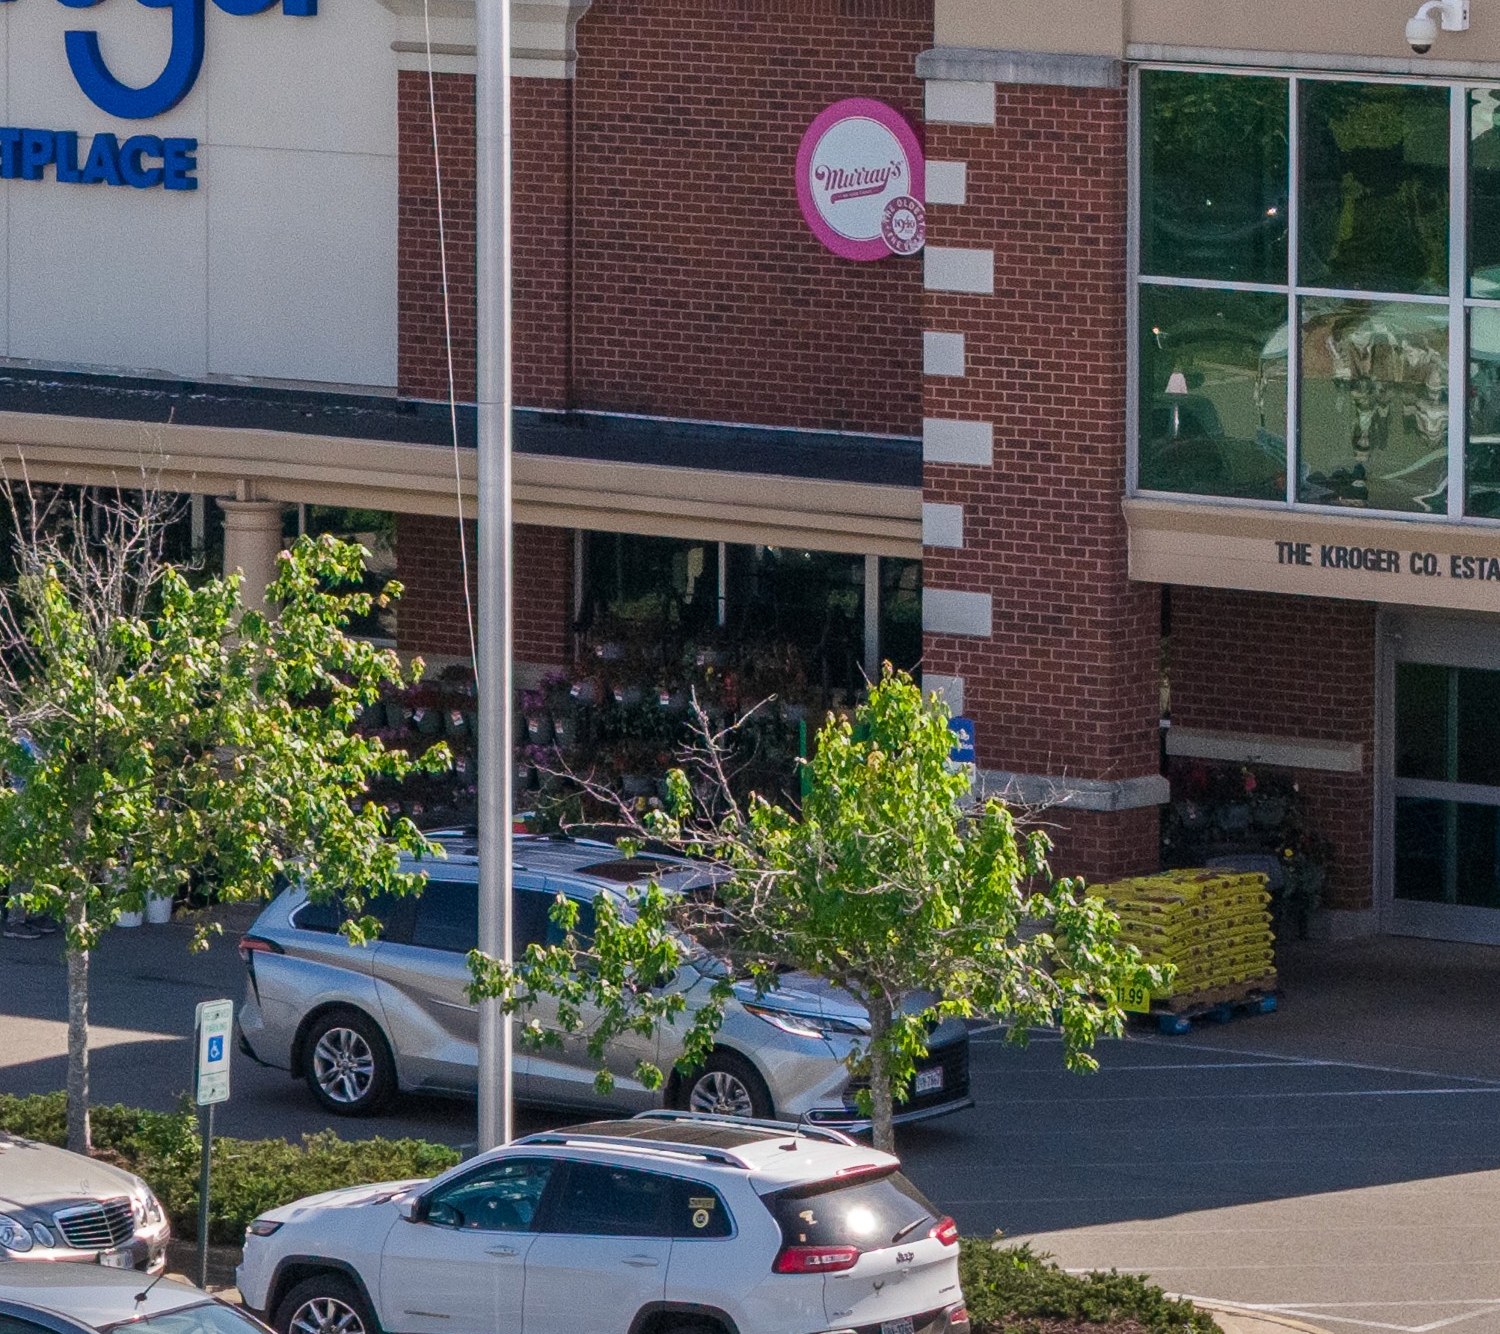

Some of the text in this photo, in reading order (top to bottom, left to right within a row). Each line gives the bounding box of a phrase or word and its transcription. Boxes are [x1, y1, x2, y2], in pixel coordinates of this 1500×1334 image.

[815, 160, 903, 191] Murray's
[1275, 541, 1312, 566] THE
[1320, 545, 1400, 573] KROGER
[1410, 552, 1441, 577] CO.
